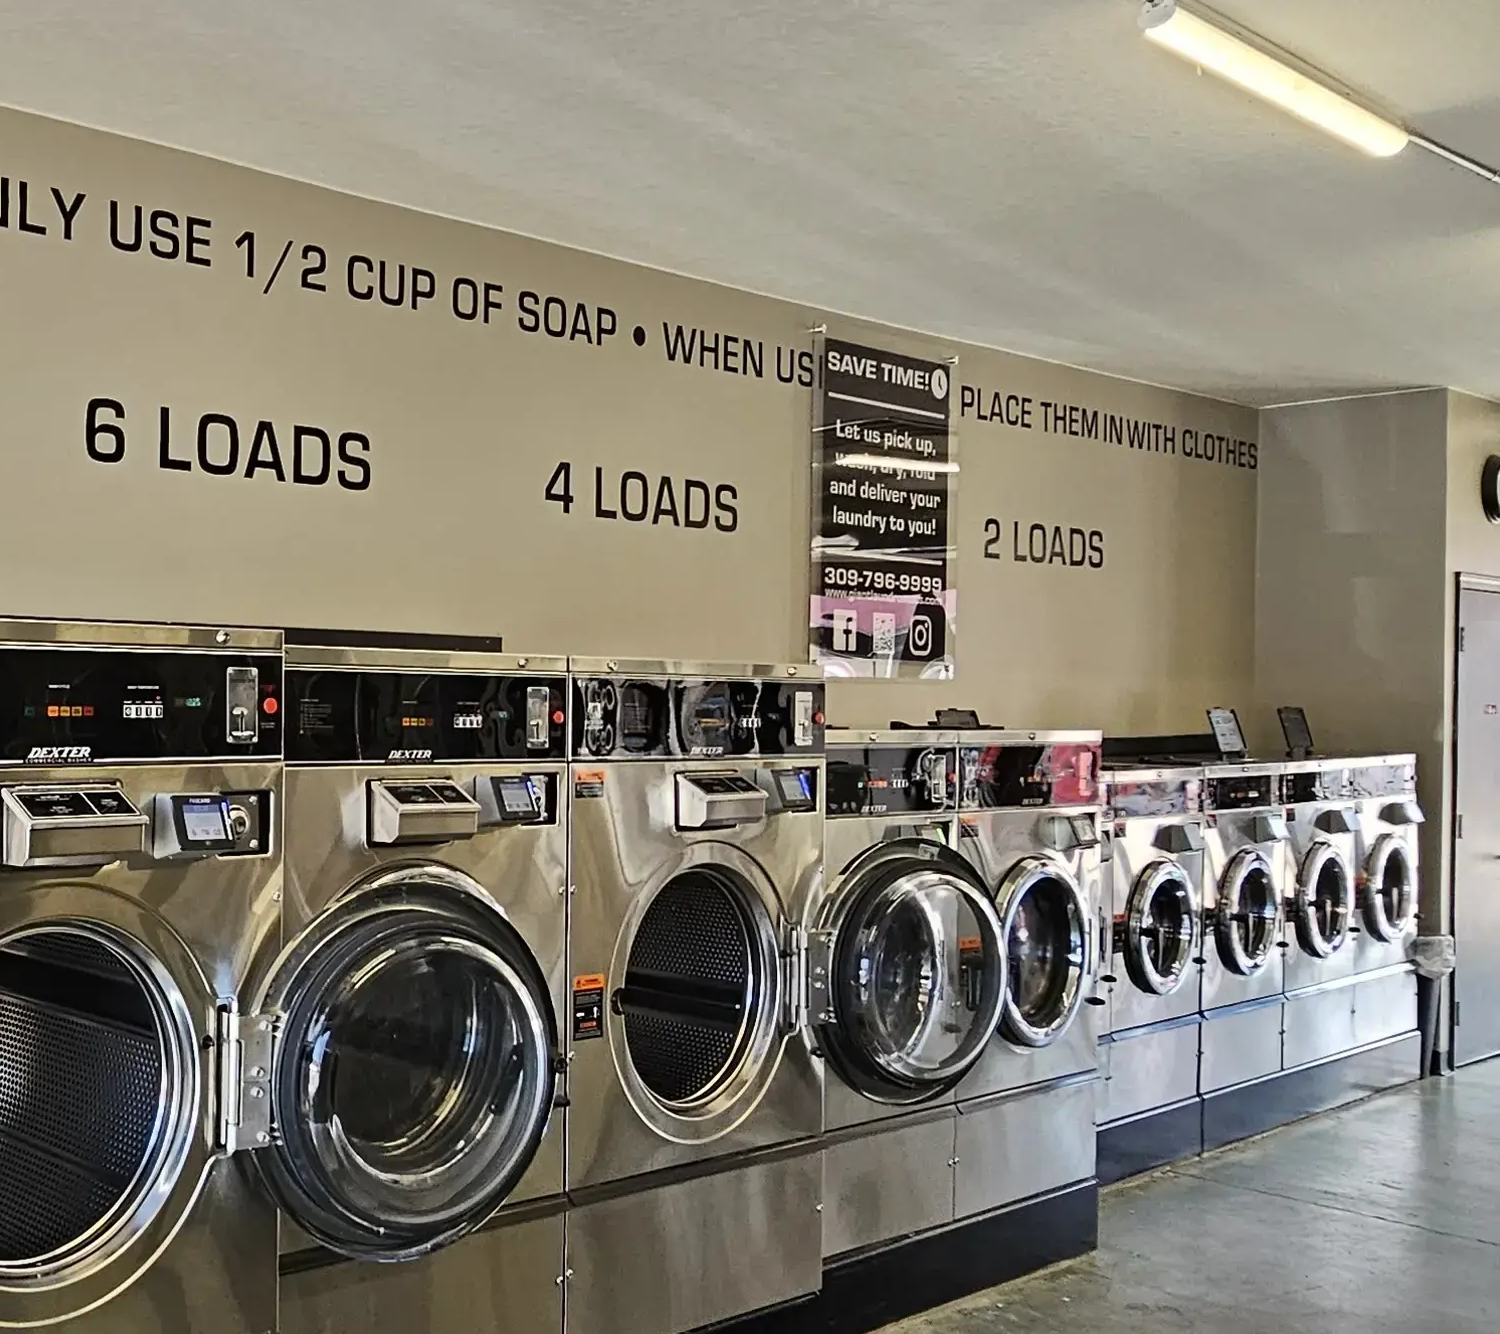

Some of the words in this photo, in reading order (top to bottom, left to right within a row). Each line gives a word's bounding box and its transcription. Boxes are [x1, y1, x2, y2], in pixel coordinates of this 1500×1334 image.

[109, 200, 212, 267] USE
[234, 230, 327, 294] 1/2
[347, 255, 436, 311] CUP
[452, 277, 503, 324] OF
[518, 291, 617, 346] SOAP
[662, 322, 763, 378] WHEN
[776, 347, 823, 389] USI
[960, 385, 1033, 429] PLACE
[1040, 402, 1099, 440] THEM
[1103, 413, 1123, 446] IN
[1126, 419, 1176, 455] WITH
[1181, 428, 1258, 470] CLOTHES
[827, 351, 877, 379] SAVE
[881, 363, 930, 391] TIME!
[85, 398, 125, 463] 6
[159, 406, 371, 491] LOADS
[836, 419, 860, 441] Let
[864, 430, 881, 444] us
[884, 429, 912, 450] pick
[916, 438, 936, 457] up,
[545, 462, 574, 514] 4
[595, 466, 738, 532] LOADS
[830, 479, 856, 498] and
[860, 481, 907, 504] deliver
[910, 492, 941, 510] your
[833, 505, 887, 534] laundry
[889, 515, 905, 532] to
[908, 518, 936, 538] you!
[984, 517, 1001, 560] 2
[1013, 520, 1104, 569] LOADS
[824, 567, 942, 593] 309-796-9999
[27, 746, 92, 759] DEXTER
[388, 749, 432, 759] DEXTER
